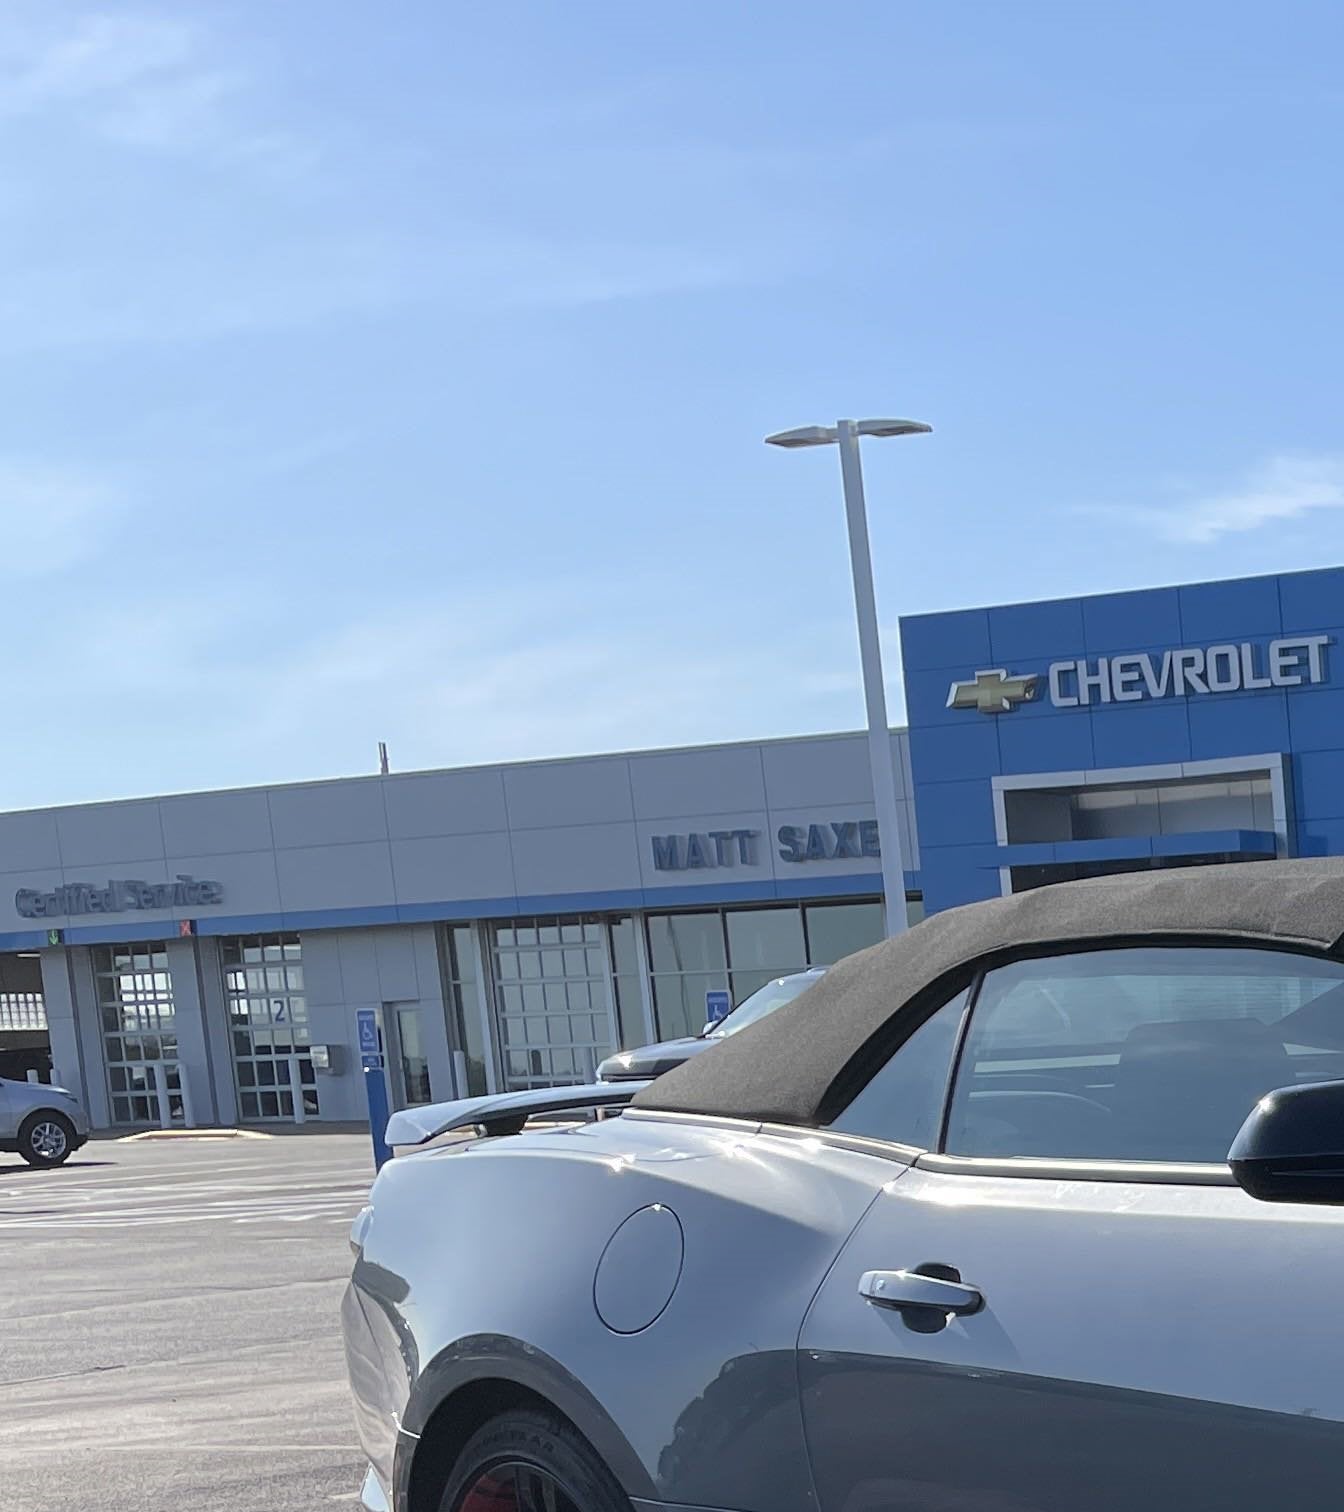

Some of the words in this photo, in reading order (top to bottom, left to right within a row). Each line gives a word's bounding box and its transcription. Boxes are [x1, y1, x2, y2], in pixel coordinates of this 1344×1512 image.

[1049, 634, 1330, 708] CHEVROLET
[651, 829, 760, 871] MATT
[777, 819, 882, 863] SAXE
[273, 1000, 286, 1022] 2
